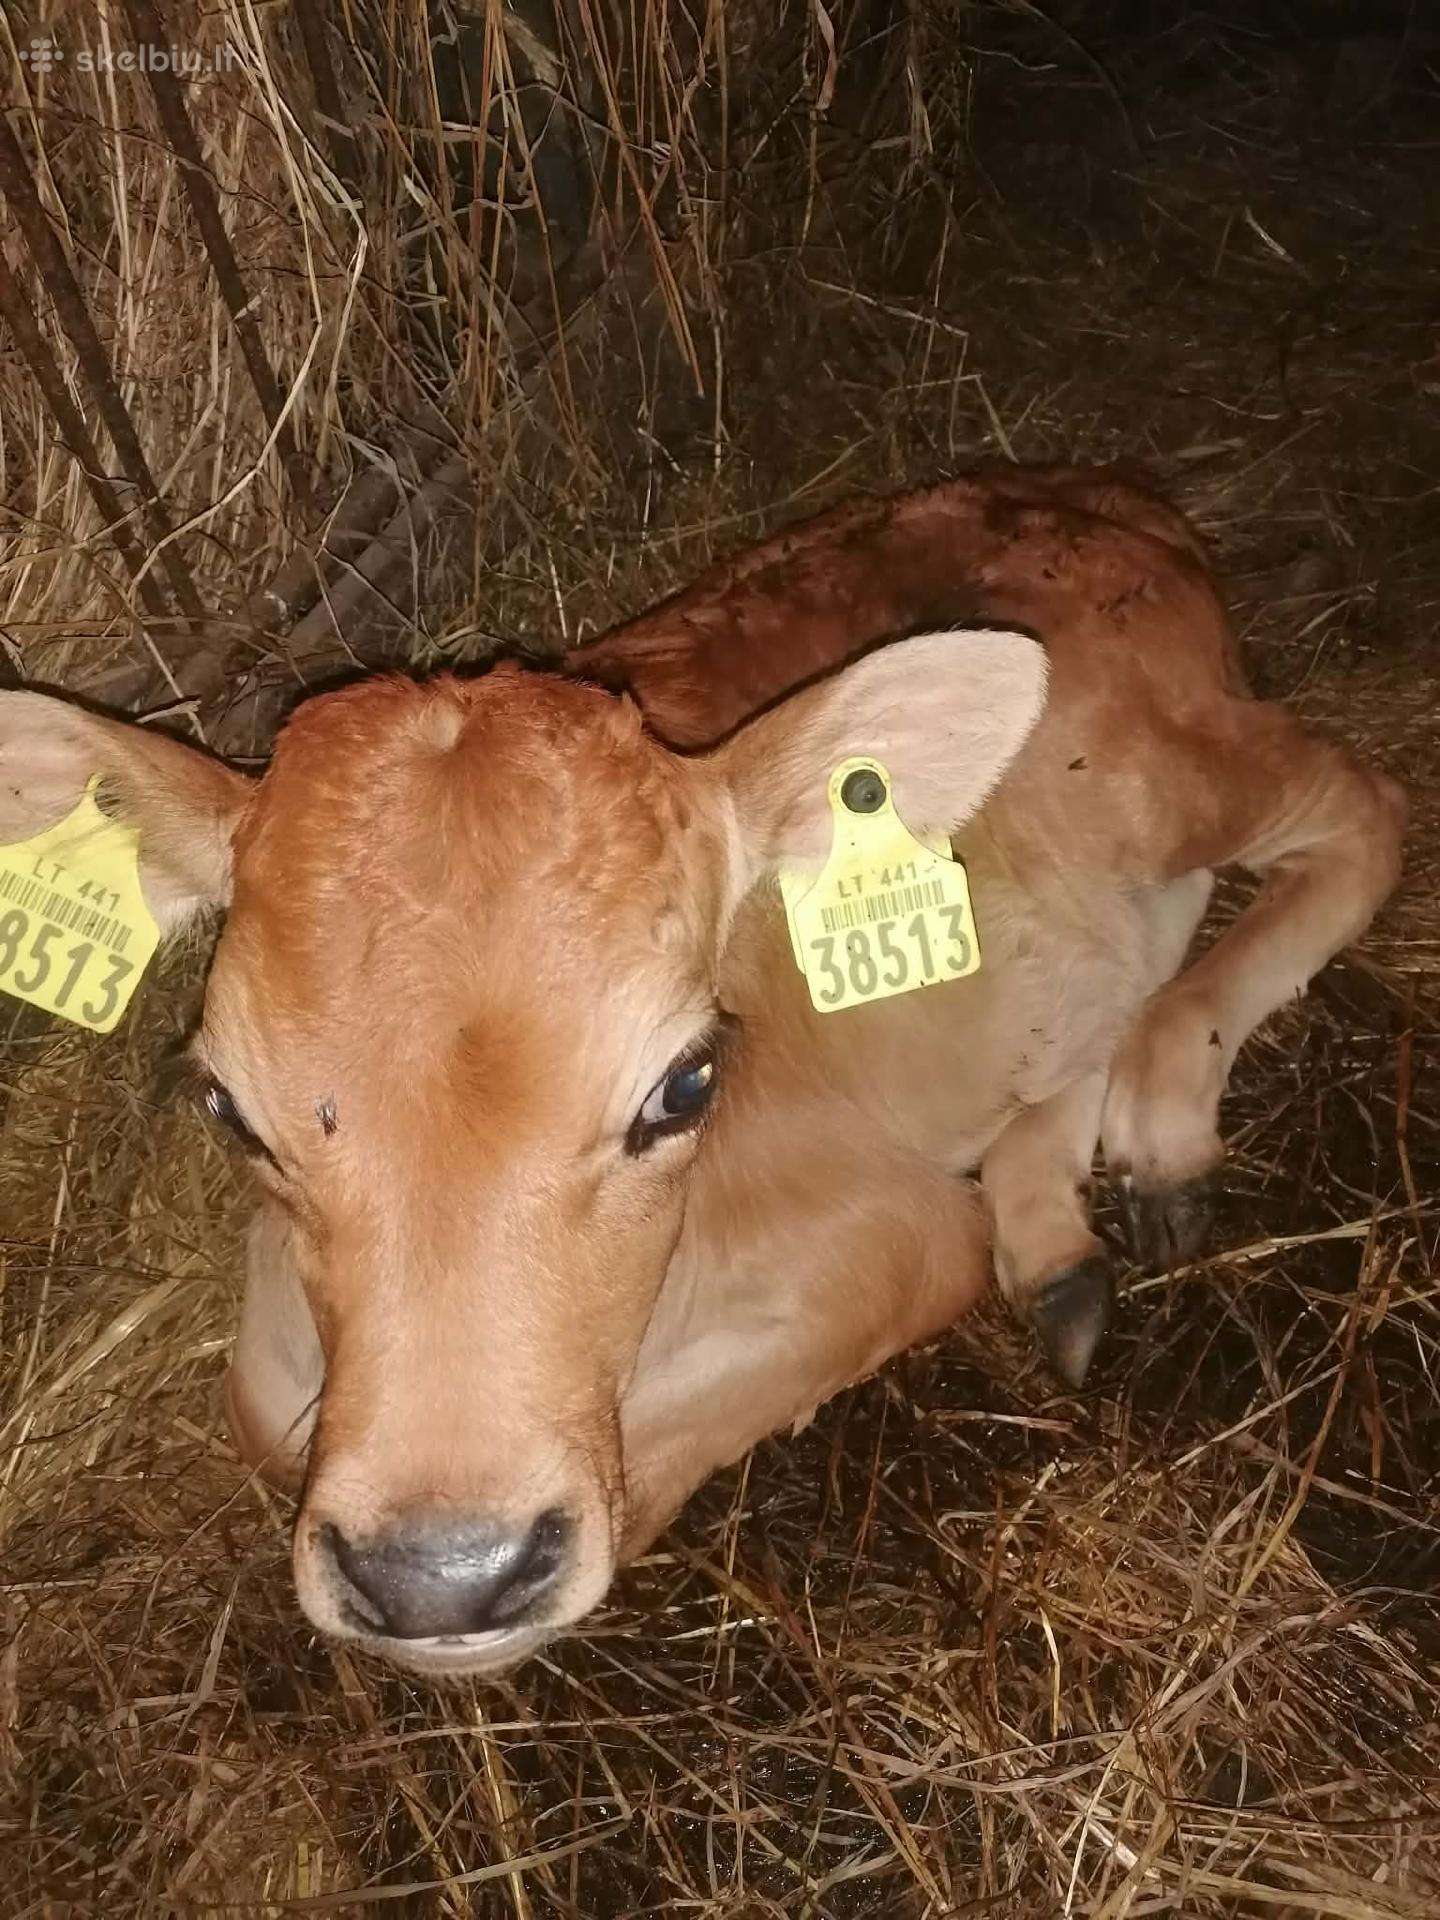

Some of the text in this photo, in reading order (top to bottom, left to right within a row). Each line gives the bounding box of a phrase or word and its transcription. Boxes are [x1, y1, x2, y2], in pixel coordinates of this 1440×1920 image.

[33, 856, 121, 912] LT 441
[837, 861, 918, 899] LT 441
[810, 903, 971, 1004] 38513
